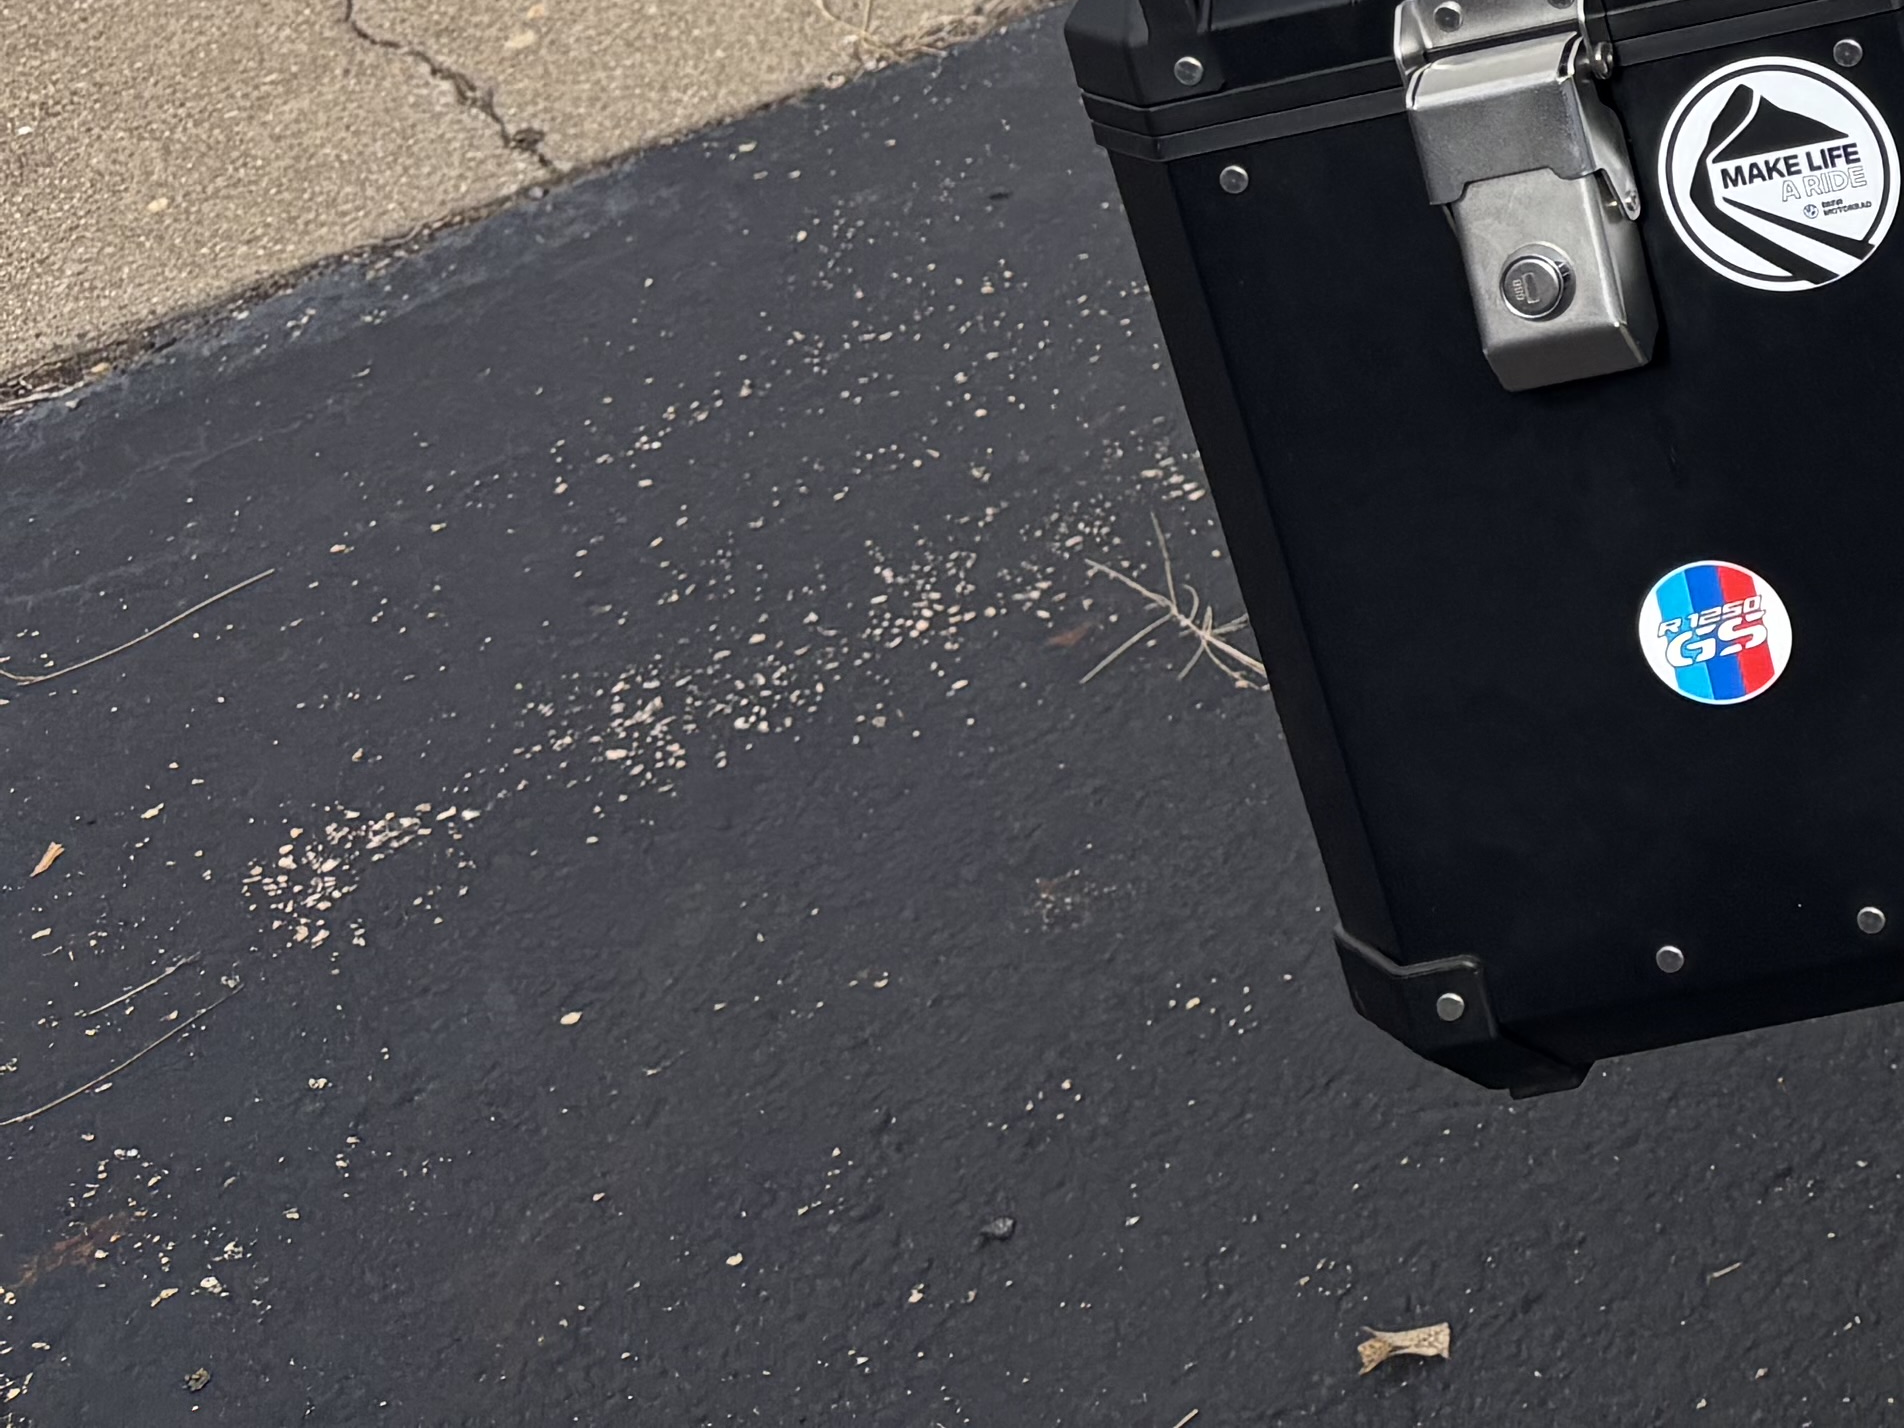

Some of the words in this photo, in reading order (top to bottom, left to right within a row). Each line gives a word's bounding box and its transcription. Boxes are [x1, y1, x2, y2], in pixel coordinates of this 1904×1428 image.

[1720, 154, 1802, 189] MAKE
[1805, 142, 1861, 172] LIFE
[1782, 180, 1802, 203] A
[1802, 165, 1868, 198] RIDE
[1657, 616, 1683, 638] R
[1686, 594, 1763, 629] 1250
[1665, 609, 1768, 668] GS
